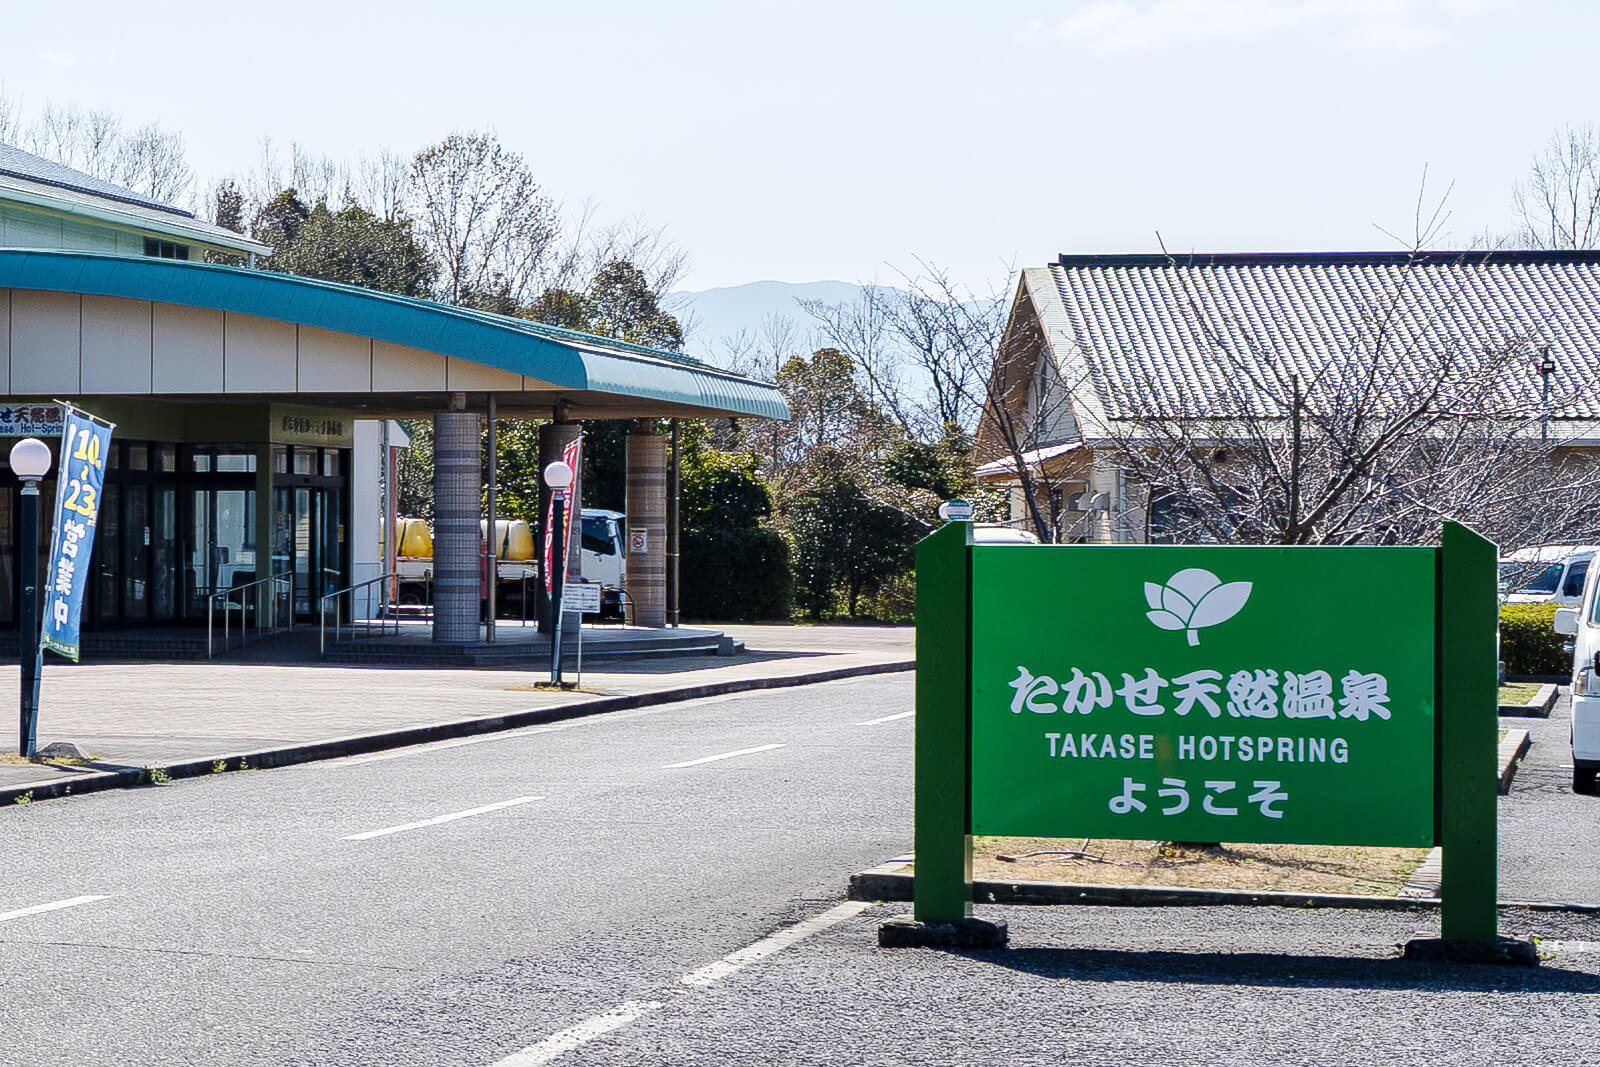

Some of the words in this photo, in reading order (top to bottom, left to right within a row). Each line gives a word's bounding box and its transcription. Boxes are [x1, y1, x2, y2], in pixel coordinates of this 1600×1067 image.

[0, 407, 65, 423] せ天然温
[20, 423, 64, 434] Hot-Sprin
[1008, 665, 1392, 721] たかせ天然温泉
[1045, 732, 1155, 760] TAKASE
[1178, 735, 1350, 764] HOTSPRING
[1109, 777, 1289, 819] ようこそ
